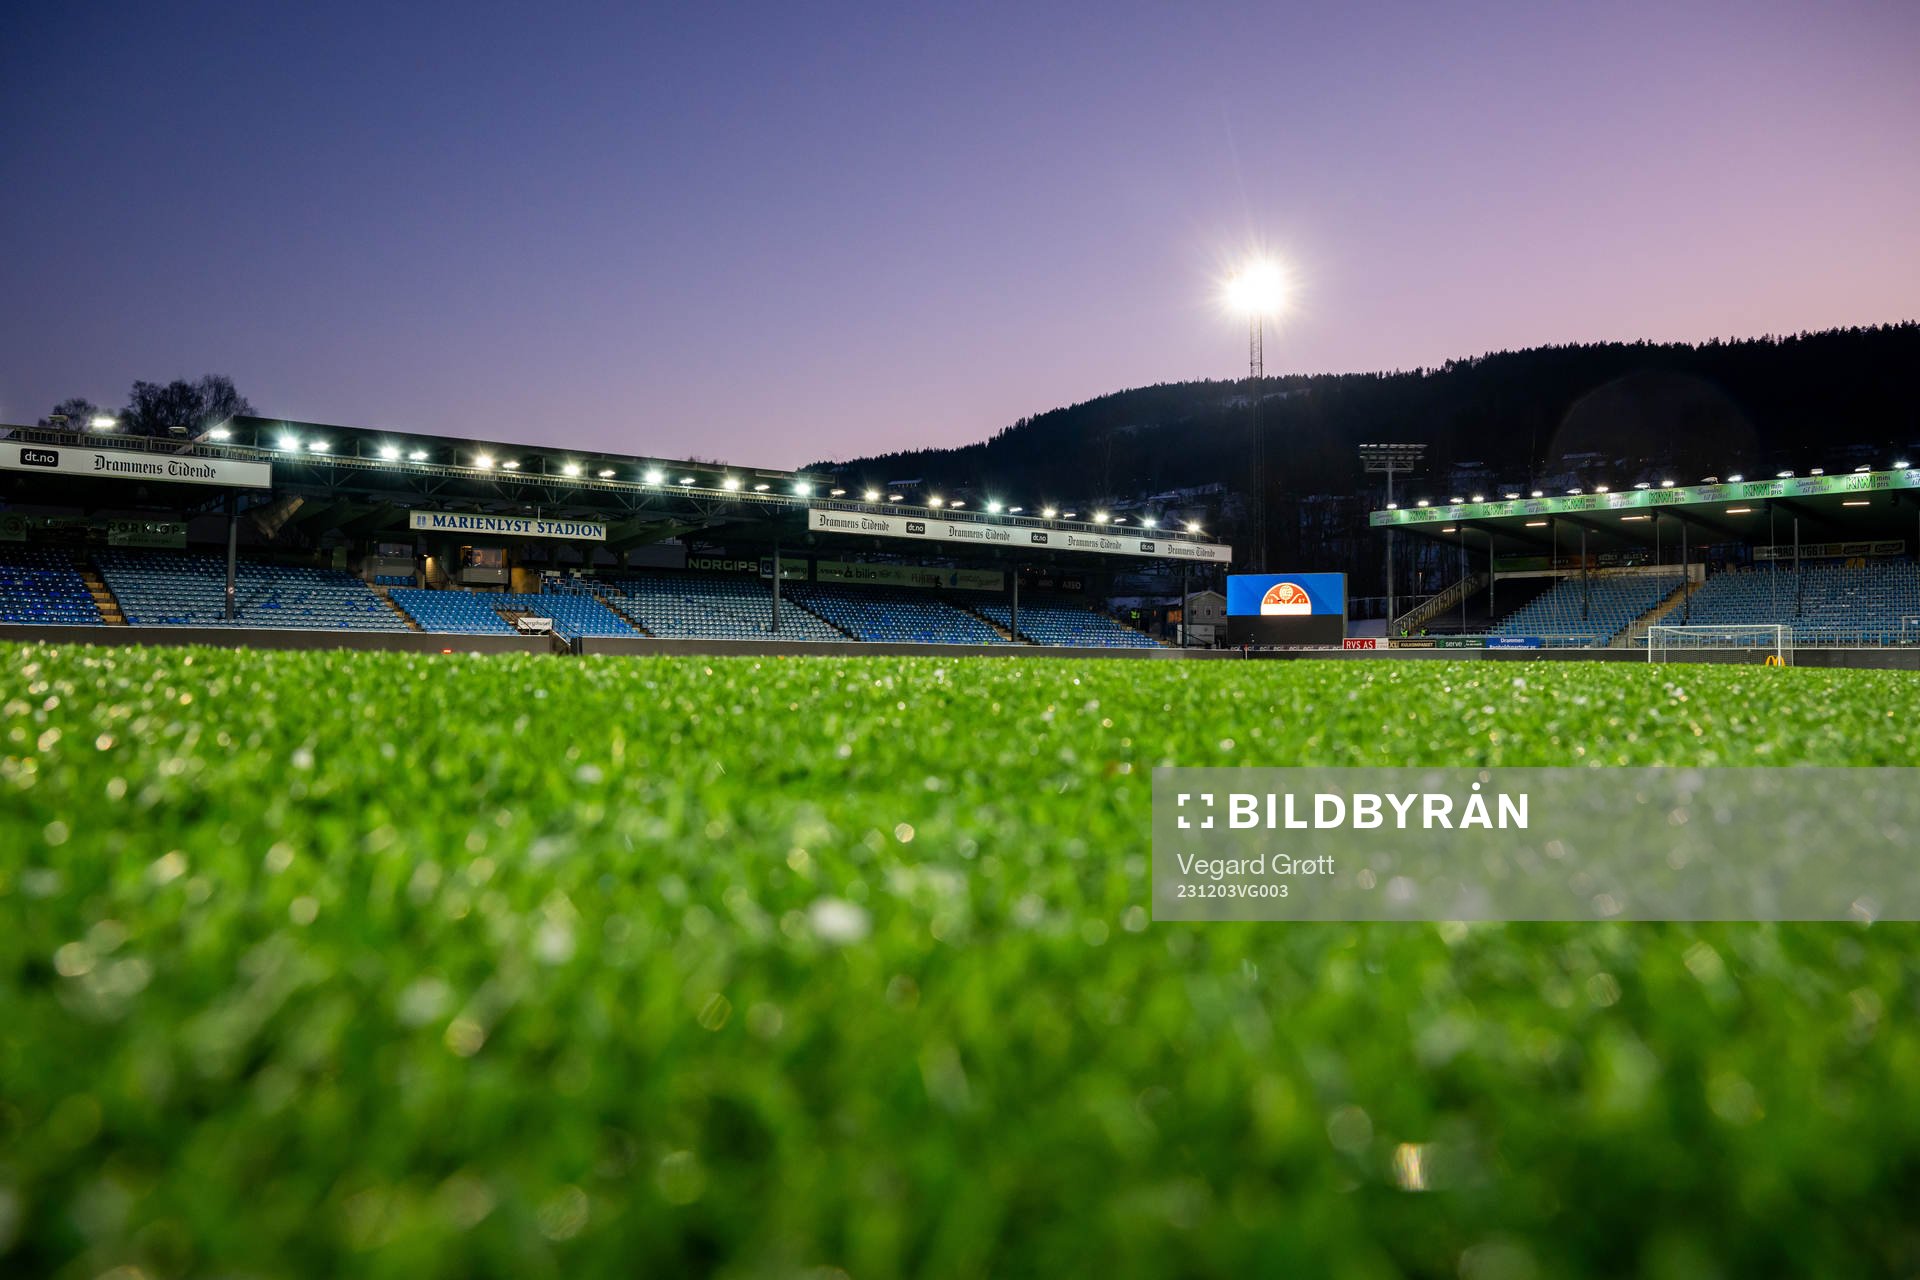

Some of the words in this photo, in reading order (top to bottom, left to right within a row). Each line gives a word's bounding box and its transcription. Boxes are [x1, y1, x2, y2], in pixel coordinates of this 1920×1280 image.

[25, 451, 55, 463] dt.no
[94, 454, 163, 475] Drammens
[168, 460, 217, 480] Tidende
[1846, 476, 1875, 490] KIWI
[1876, 474, 1891, 482] mini
[1876, 480, 1889, 488] pris
[1649, 490, 1673, 503] KIWI
[1743, 484, 1770, 497] KIWI
[432, 515, 532, 532] MARIENLYST
[537, 521, 602, 537] STADION
[819, 514, 859, 529] Drammens
[862, 517, 890, 532] Tidende
[948, 525, 984, 539] Drammens
[985, 528, 1011, 541] Tidende
[1067, 535, 1099, 548] Drammens
[1099, 537, 1122, 549] Tidende
[1167, 544, 1195, 555] Drammens
[1195, 546, 1216, 557] Tidende
[688, 558, 758, 571] NORGIPS
[1346, 640, 1361, 649] RVS
[1363, 640, 1373, 649] AS
